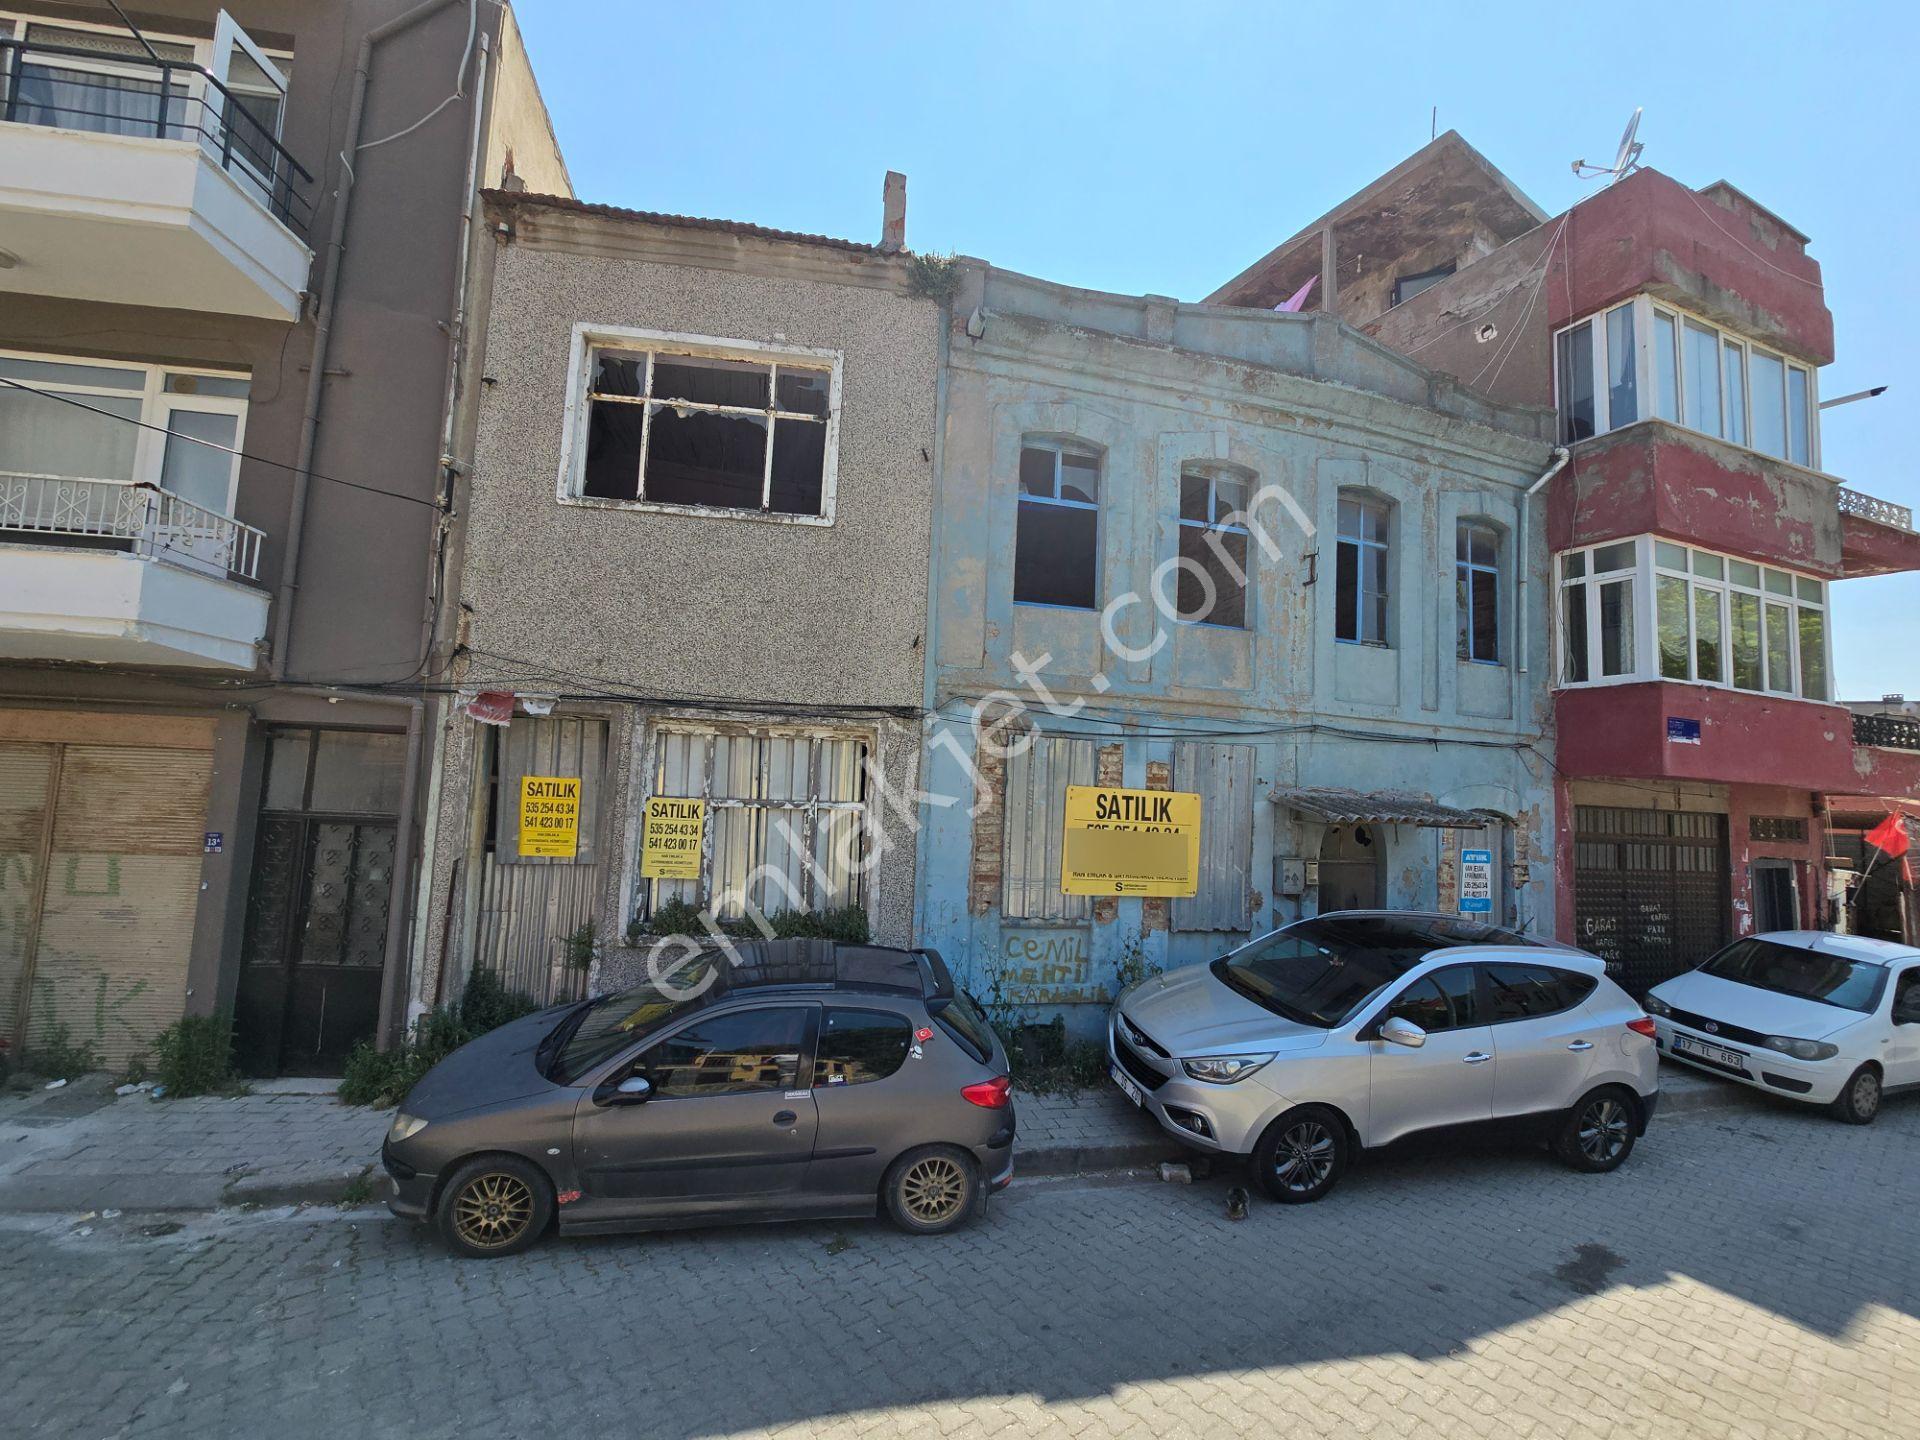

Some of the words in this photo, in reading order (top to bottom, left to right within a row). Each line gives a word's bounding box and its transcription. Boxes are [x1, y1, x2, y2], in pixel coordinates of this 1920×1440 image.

[527, 782, 577, 798] SATILIK
[525, 801, 539, 813] 535
[540, 802, 553, 814] 254
[555, 803, 564, 814] 43
[566, 803, 574, 814] 34
[651, 802, 701, 819] SATILIK
[1096, 793, 1173, 822] SATILIK
[524, 816, 537, 827] 541
[539, 817, 553, 828] 423
[555, 817, 563, 828] 00
[566, 817, 574, 829] 17
[650, 823, 664, 834] 535
[665, 823, 678, 835] 254
[680, 824, 688, 835] 43
[690, 824, 698, 836] 34
[649, 837, 662, 849] 541
[663, 838, 677, 850] 423
[678, 838, 687, 850] 00
[690, 839, 697, 850] 17
[1681, 1039, 1692, 1050] 17
[1701, 1046, 1713, 1057] TL
[1720, 1052, 1741, 1066] 663
